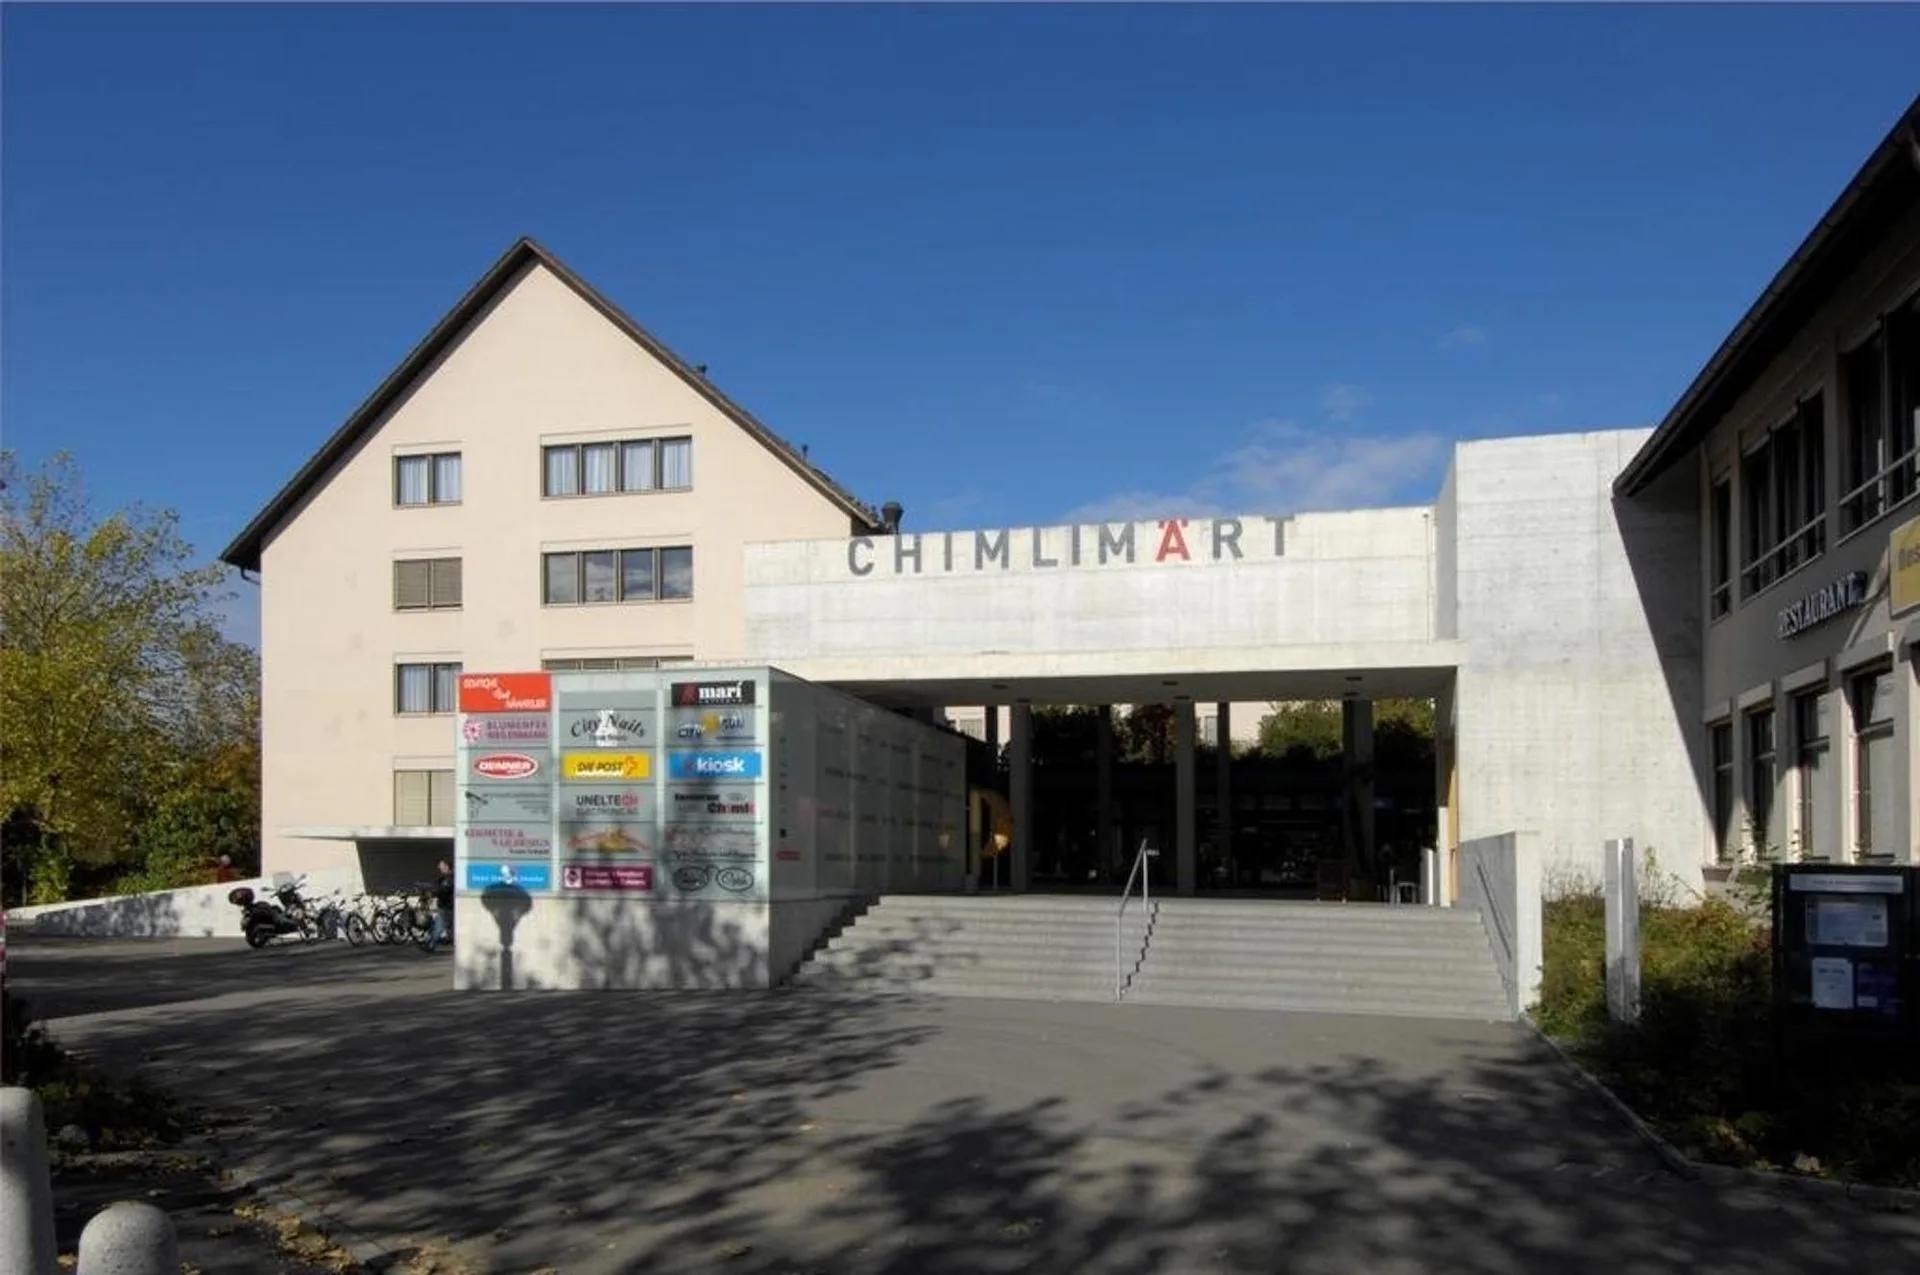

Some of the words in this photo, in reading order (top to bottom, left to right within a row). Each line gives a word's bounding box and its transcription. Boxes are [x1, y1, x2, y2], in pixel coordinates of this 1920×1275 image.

[847, 516, 1295, 577] CHIMLIMÄRT
[571, 718, 601, 737] City
[606, 713, 645, 738] Nails
[479, 761, 532, 771] DENNER
[577, 761, 596, 773] DIE
[596, 760, 623, 772] POST
[697, 757, 745, 772] kiosk
